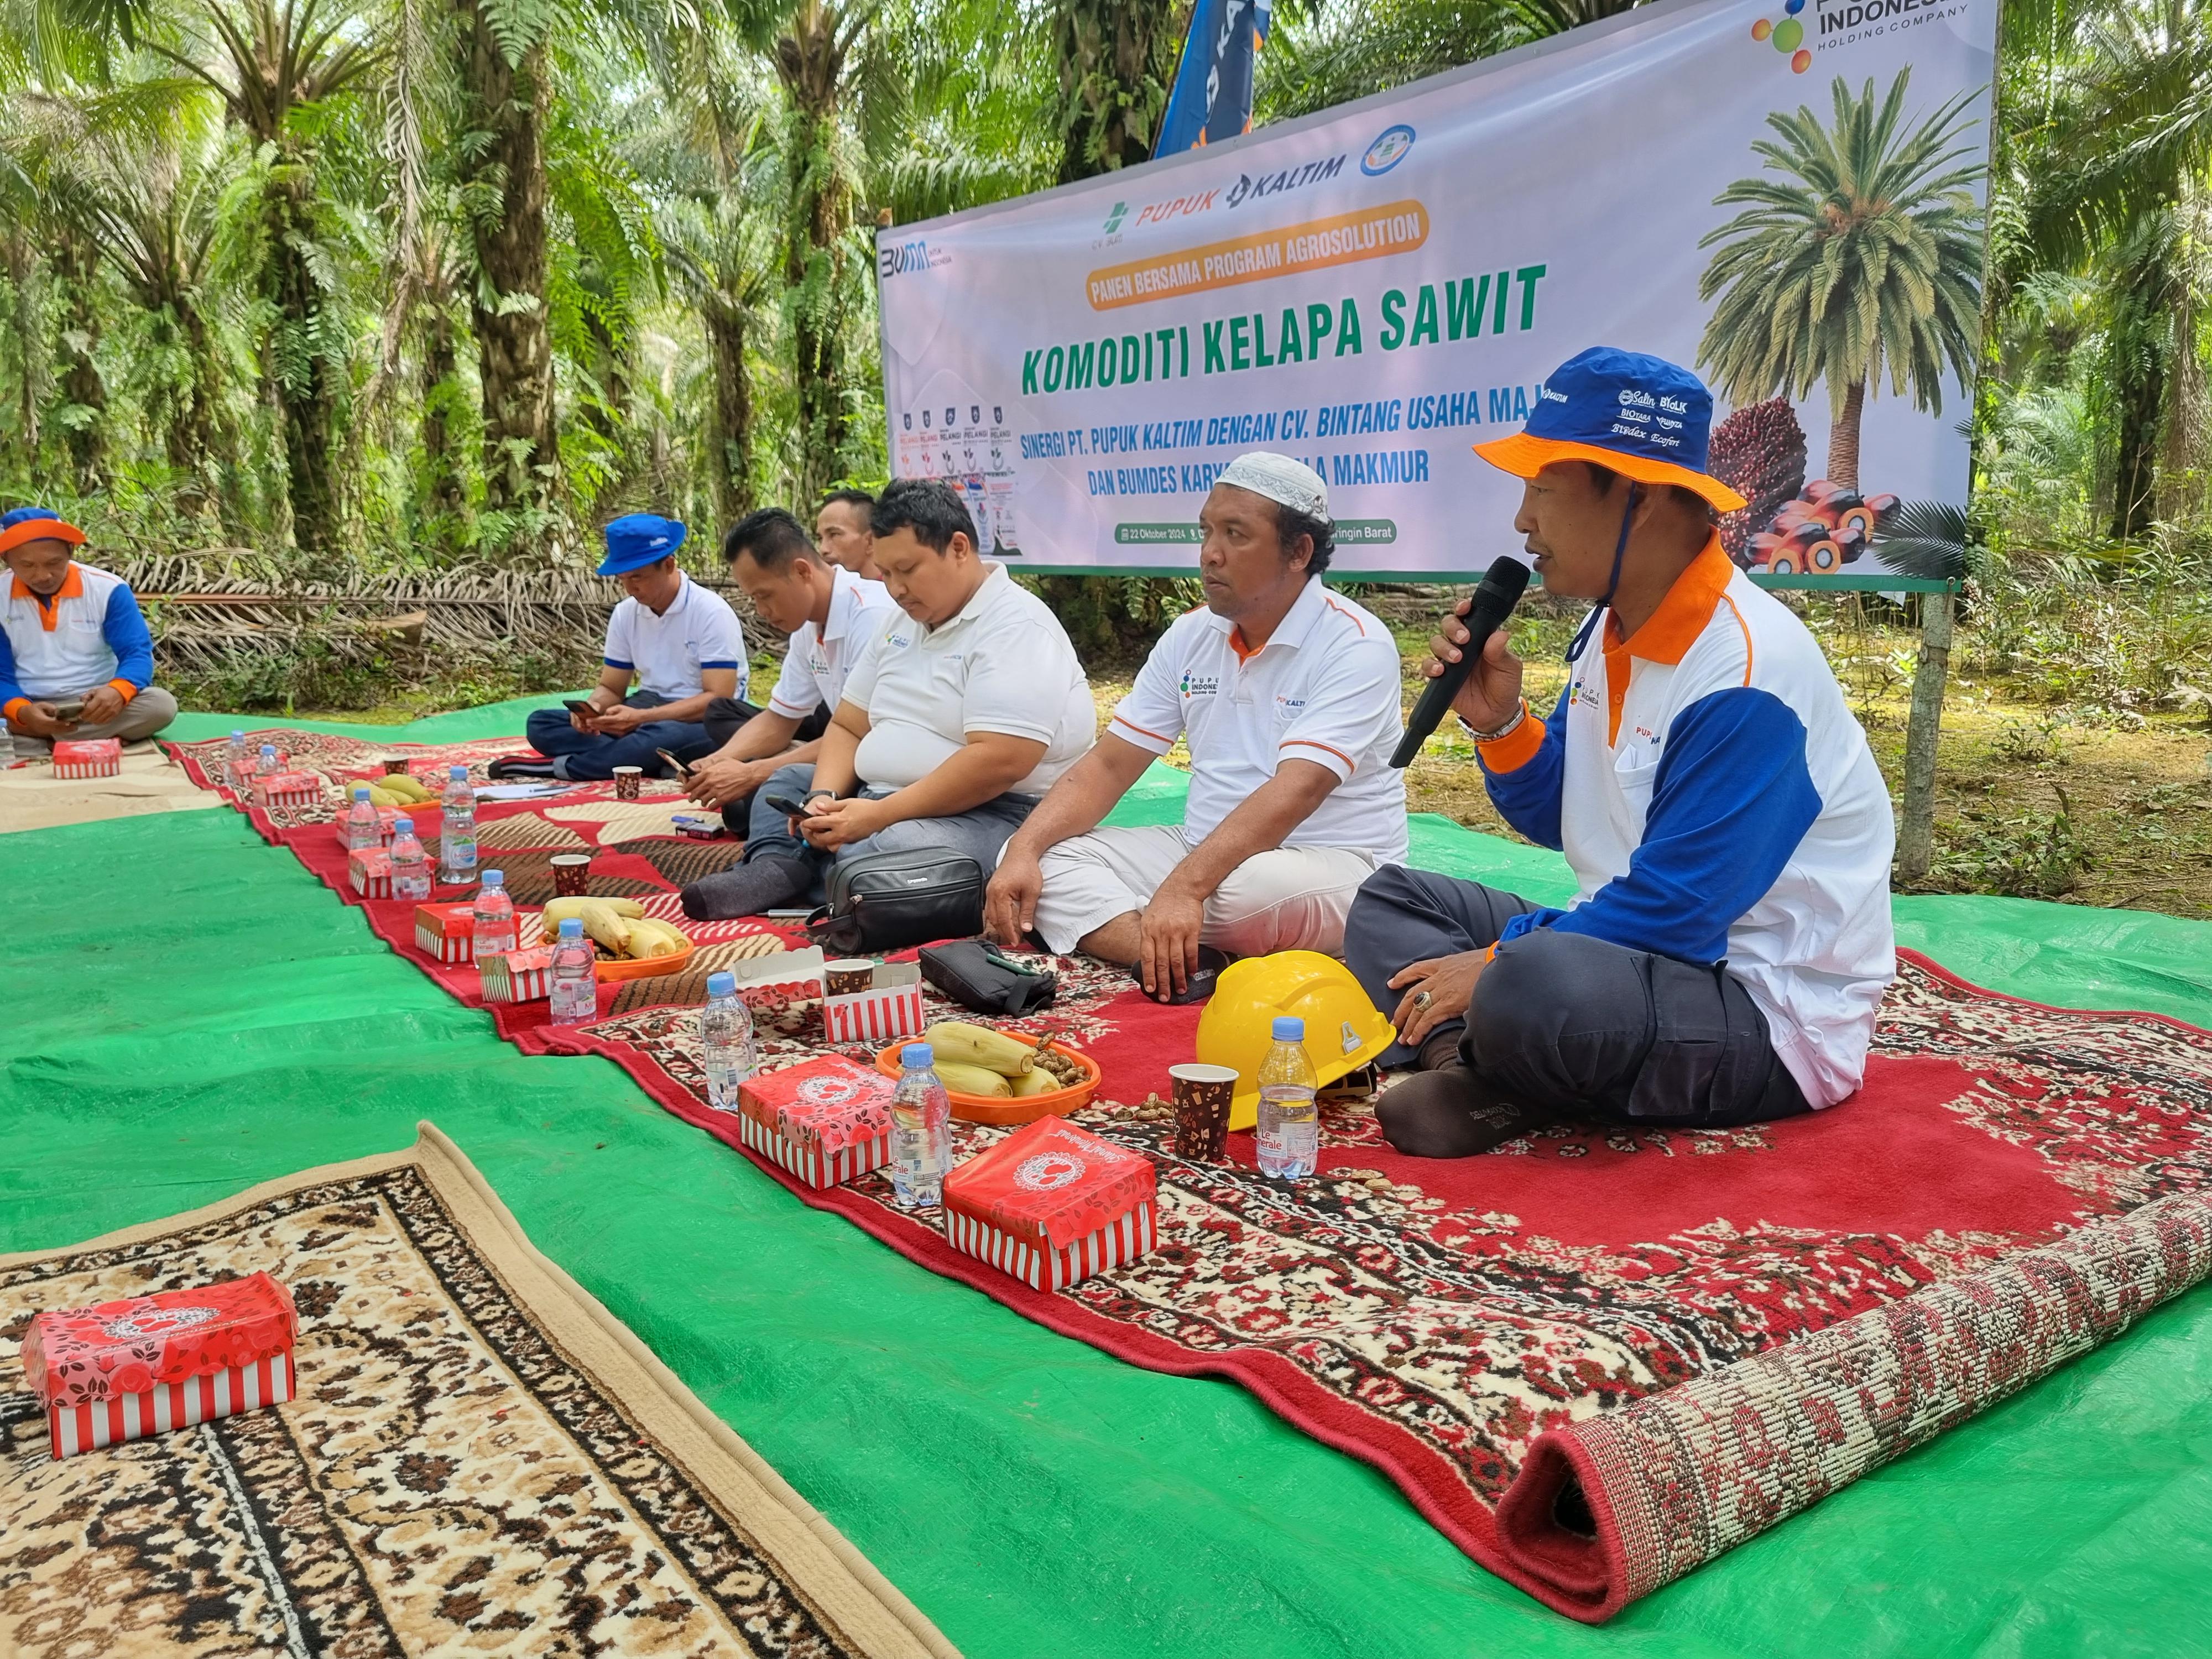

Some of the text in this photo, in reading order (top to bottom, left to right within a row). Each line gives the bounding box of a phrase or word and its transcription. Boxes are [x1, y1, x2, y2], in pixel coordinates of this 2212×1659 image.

[1818, 27, 1884, 51] HOLDING
[1890, 4, 1968, 32] COMPANY
[1820, 0, 1954, 35] INDONE
[1136, 154, 1347, 227] PUPUK KALTIM
[1091, 212, 1421, 302] PANEN BERSAMA PROGRAM AGROSOLUTION
[1022, 264, 1547, 396] KOMODITI KELAPA SAWIT
[1020, 384, 1542, 460] SINERGI PT. PUPUK KALTIM DENGAN CV. BINTANG USAHA MAJ
[1087, 462, 1231, 495] DAN BUMDES KARY
[1333, 449, 1429, 486] MAKMUR
[1129, 528, 1139, 539] 22
[1139, 528, 1168, 539] Oktober
[1168, 528, 1186, 539] 2024
[1364, 526, 1392, 538] Barat
[1261, 1128, 1270, 1140] Le
